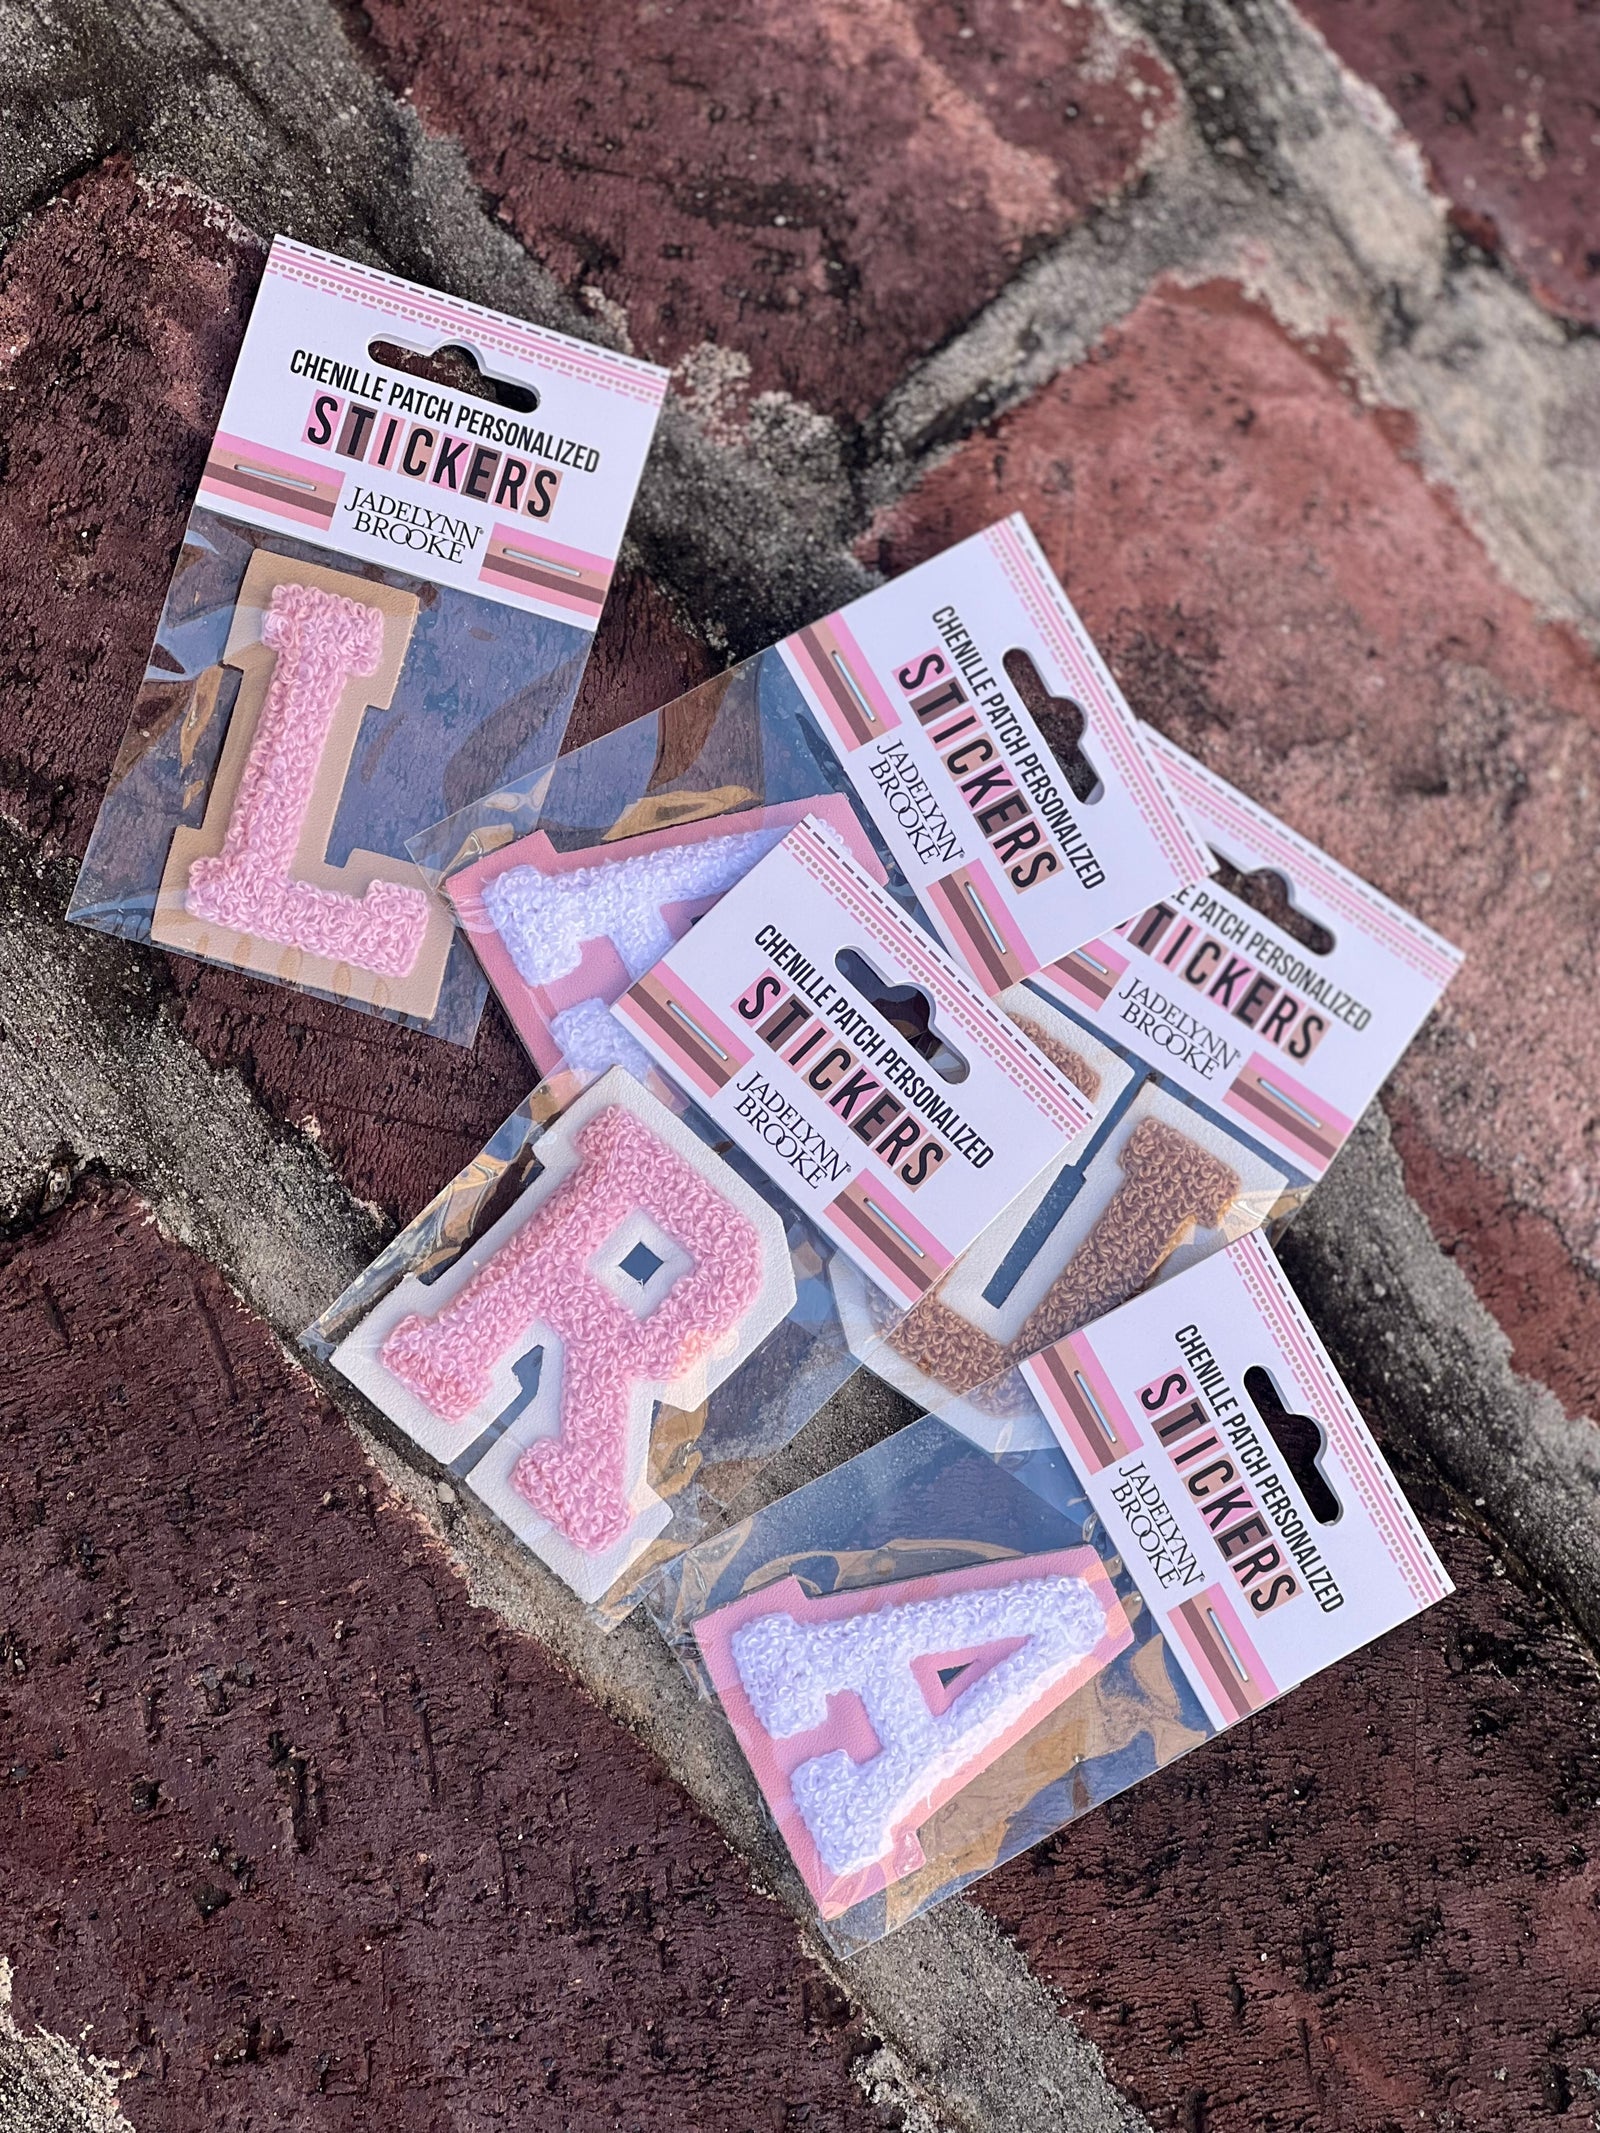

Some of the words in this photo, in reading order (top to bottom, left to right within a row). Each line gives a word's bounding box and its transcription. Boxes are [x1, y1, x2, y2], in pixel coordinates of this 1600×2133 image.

[290, 349, 387, 402] CHENILLE
[388, 383, 454, 425] PATCH
[455, 409, 600, 474] PERSONALIZED
[307, 395, 558, 519] STICKERS
[344, 486, 484, 550] JADELYNN
[352, 511, 466, 564] BROOKE
[877, 739, 965, 864] JADELYNN
[899, 653, 1058, 888] STICKERS
[932, 605, 998, 698] CHENILLE
[981, 694, 1028, 754] PATCH
[1015, 752, 1106, 890] PERSONALIZED
[868, 760, 941, 865] BROOKE
[1115, 903, 1324, 1062] TICKERS
[1189, 891, 1249, 945] PATCH
[1245, 926, 1373, 1032] PERSONALIZED
[738, 976, 944, 1186] STICKERS
[754, 924, 836, 1007] CHENILLE
[827, 995, 885, 1059] PATCH
[877, 1045, 996, 1170] PERSONALIZED
[1118, 977, 1241, 1072] JADELYNN
[1120, 1003, 1220, 1081] BROOKE
[733, 1096, 831, 1190] BROOKE
[735, 1071, 851, 1182] JADELYNN
[1119, 1460, 1205, 1586] JADELYNN
[1140, 1373, 1297, 1613] STICKERS
[1174, 1324, 1239, 1417] CHENILLE
[1222, 1410, 1273, 1479] PATCH
[1254, 1471, 1345, 1613] PERSONALIZED
[1110, 1485, 1183, 1590] BROOKE
